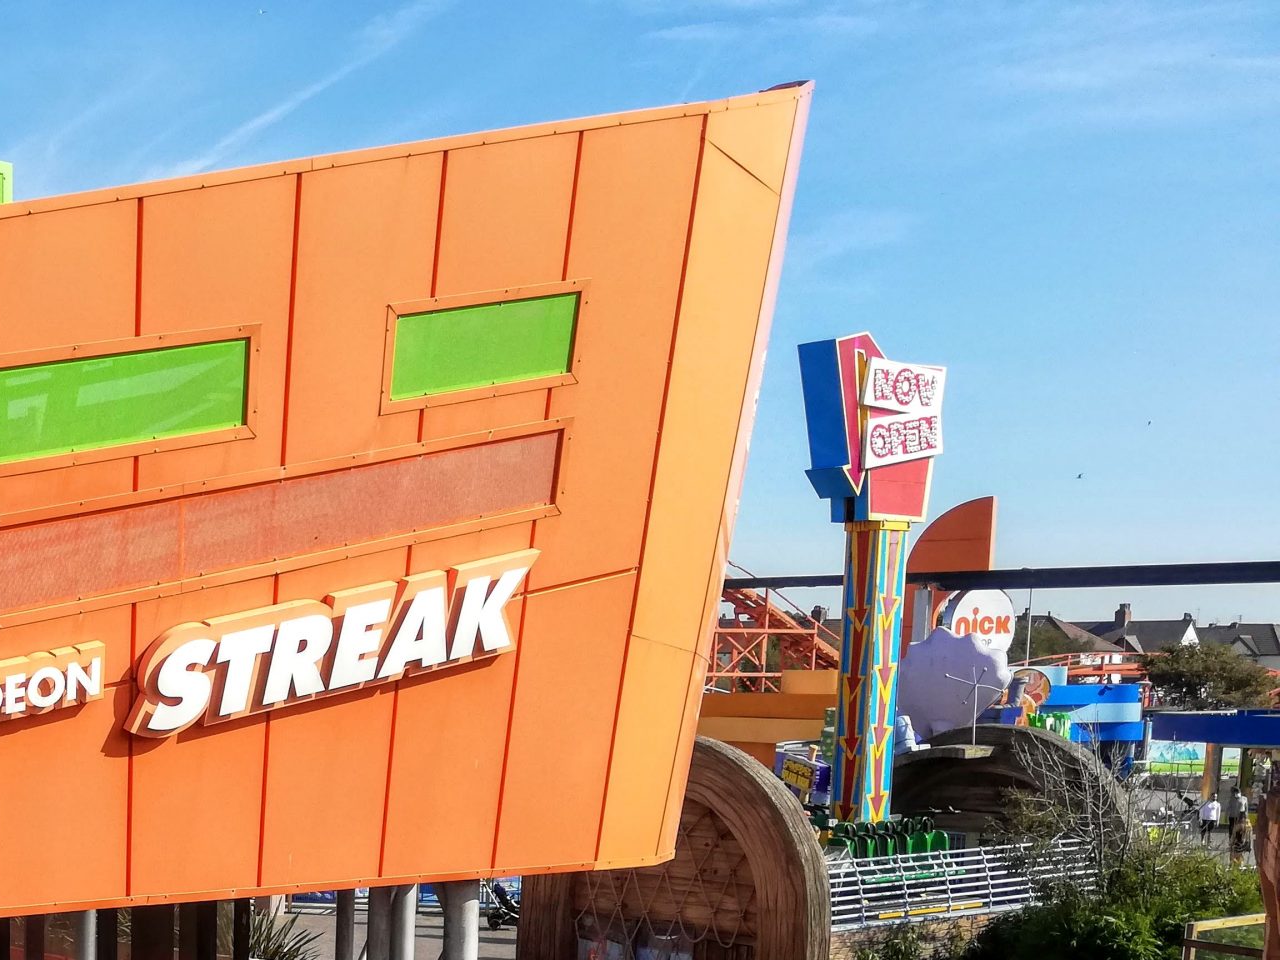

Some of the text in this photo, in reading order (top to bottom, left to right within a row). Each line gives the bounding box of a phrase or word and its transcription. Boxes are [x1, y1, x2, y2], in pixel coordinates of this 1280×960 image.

[874, 368, 936, 406] NOW
[871, 416, 937, 458] OPEN
[148, 566, 531, 732] STREAK
